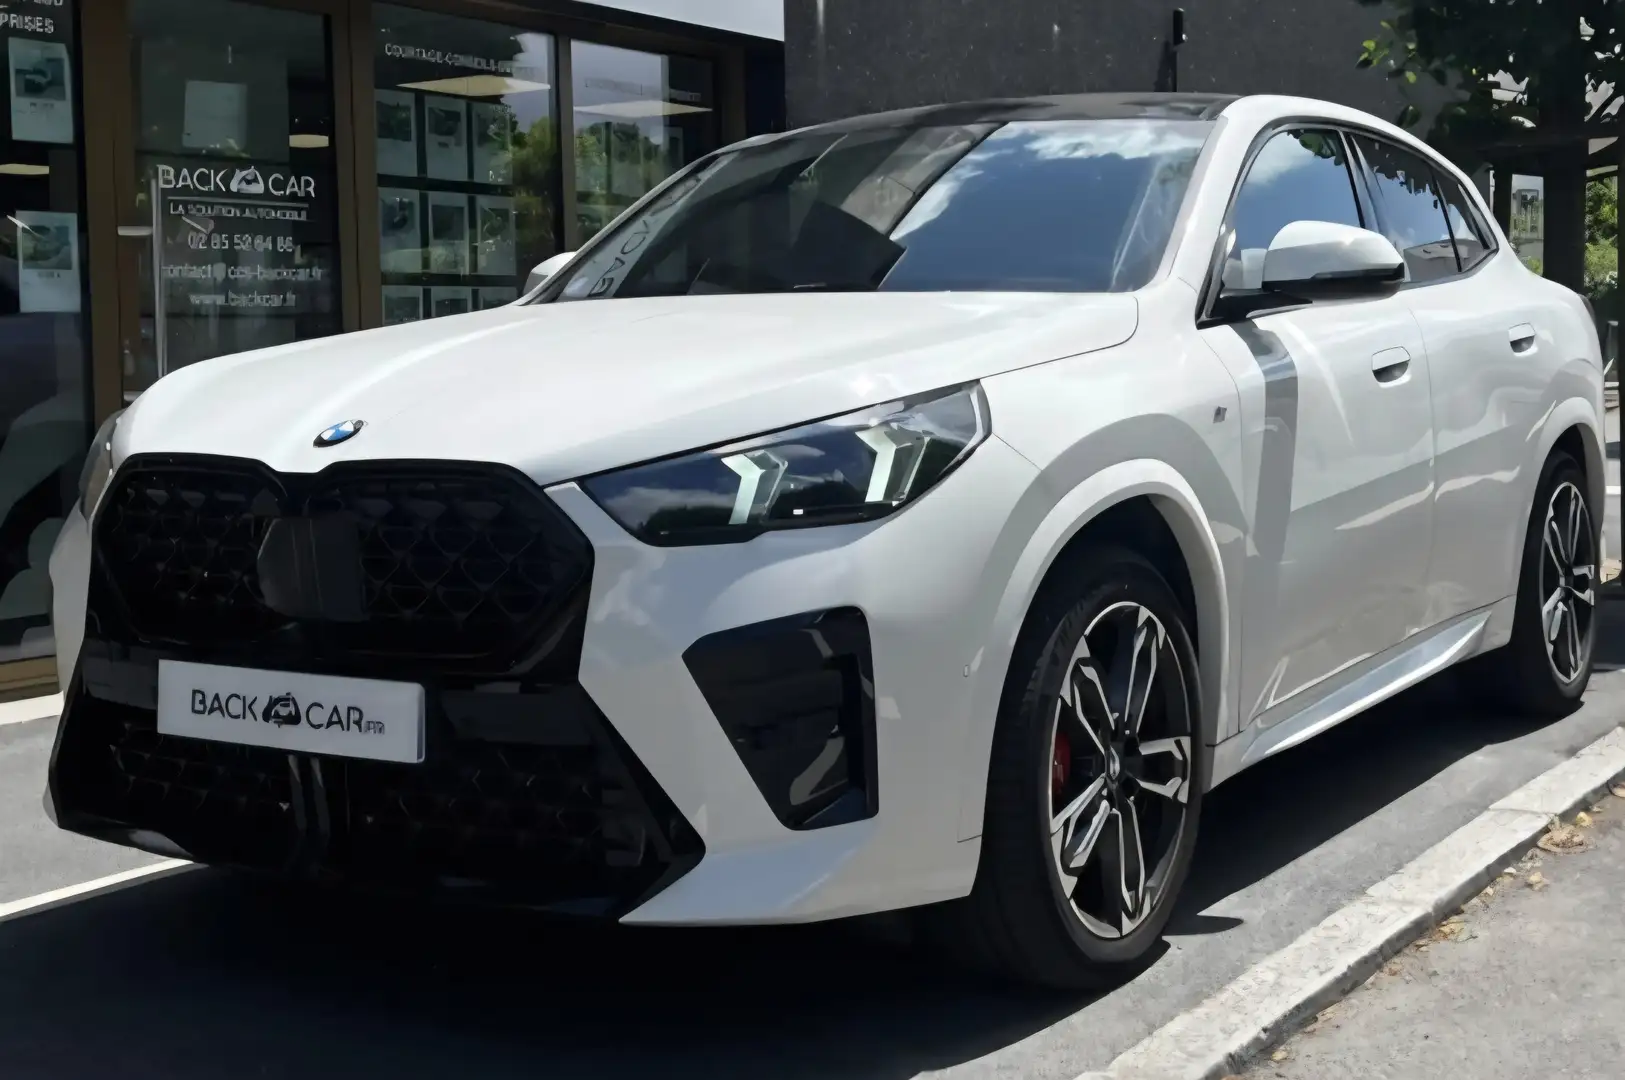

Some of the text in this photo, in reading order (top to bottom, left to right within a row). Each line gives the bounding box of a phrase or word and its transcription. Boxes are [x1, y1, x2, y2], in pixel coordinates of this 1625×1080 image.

[157, 164, 316, 198] BACK CAR
[191, 688, 258, 722] BACK
[305, 701, 364, 734] CAR
